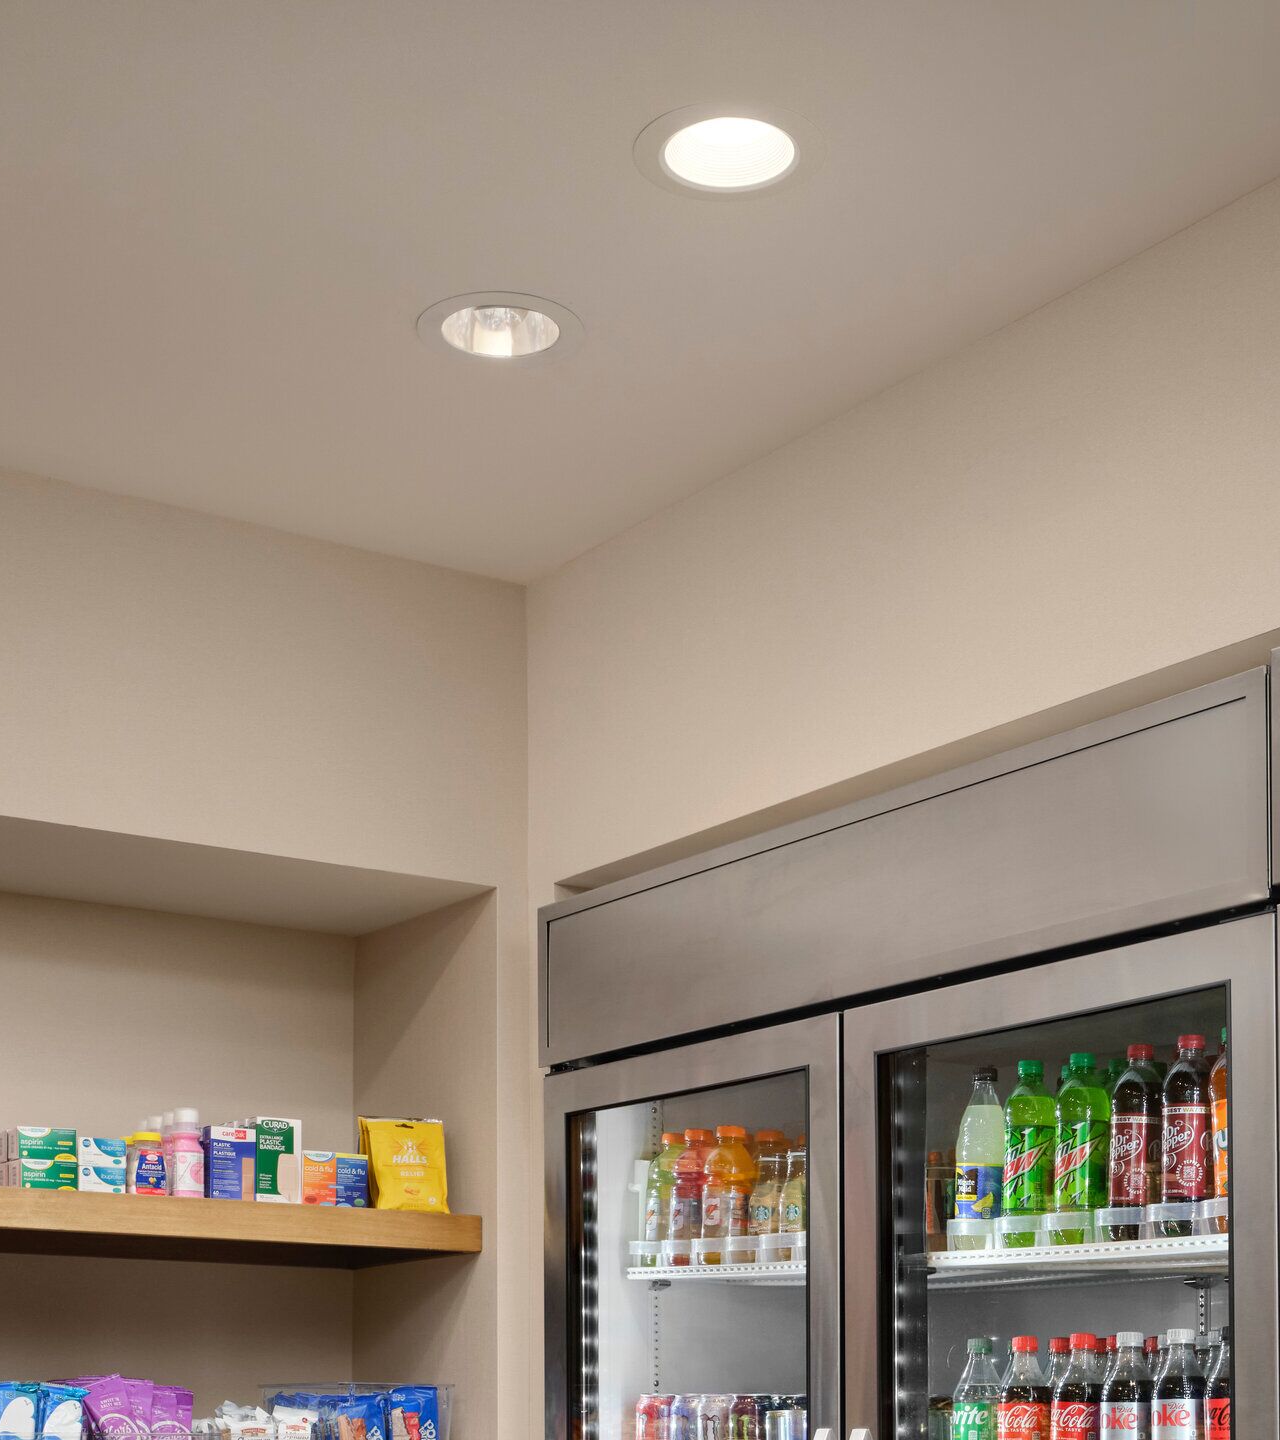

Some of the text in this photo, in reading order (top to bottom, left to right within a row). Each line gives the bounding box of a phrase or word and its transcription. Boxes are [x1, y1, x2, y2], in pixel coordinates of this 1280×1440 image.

[20, 1138, 44, 1147] aspirin
[392, 1154, 428, 1166] HALLS
[23, 1171, 46, 1180] aspirin
[337, 1167, 351, 1175] cold
[1167, 1401, 1186, 1410] Diet
[1101, 1407, 1137, 1431] oke
[1152, 1403, 1191, 1427] oke
